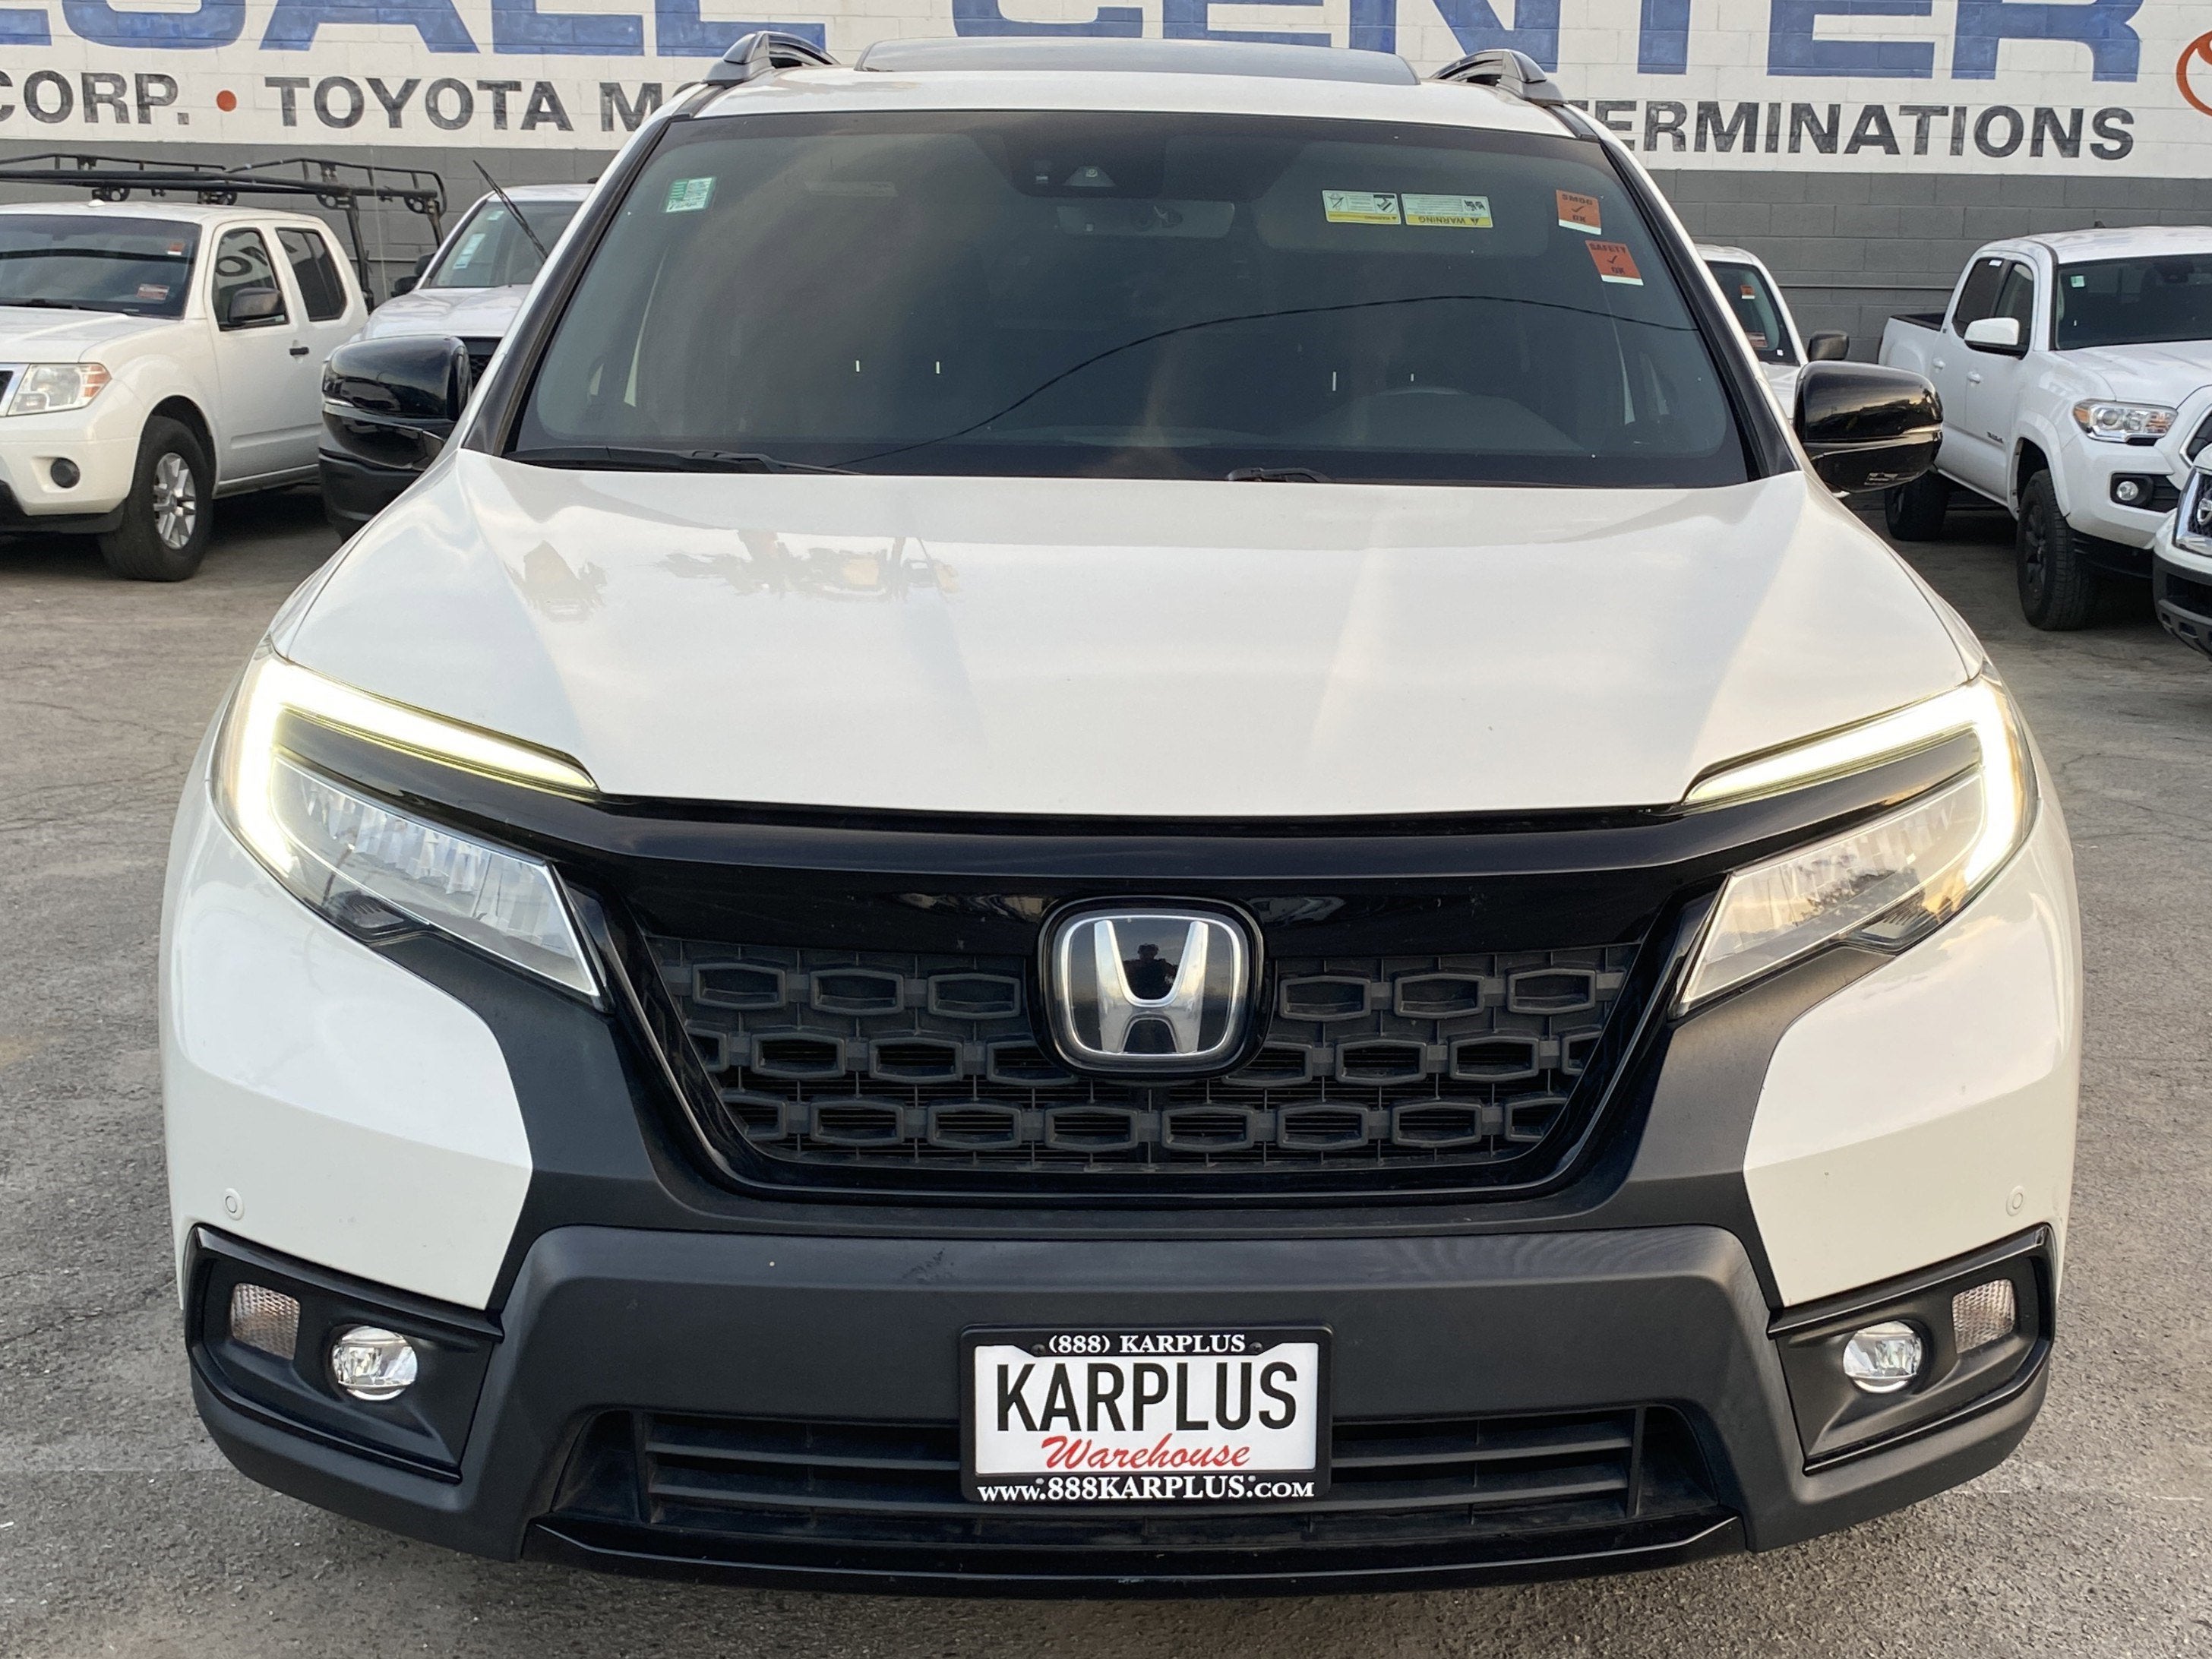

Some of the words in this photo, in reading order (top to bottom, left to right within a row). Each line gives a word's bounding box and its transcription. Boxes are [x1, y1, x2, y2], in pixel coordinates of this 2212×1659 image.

[264, 75, 574, 132] TOYOTA
[1567, 100, 2135, 161] ERMINATIONS
[1561, 194, 1593, 205] SMOG
[1417, 216, 1467, 225] WARNING
[1572, 214, 1586, 223] OK
[1589, 242, 1626, 254] SAFETY
[1048, 1335, 1111, 1354] (888)
[1119, 1334, 1246, 1354] KARPLUS
[997, 1361, 1297, 1432] KARPLUS
[1041, 1433, 1250, 1470] Warehouse
